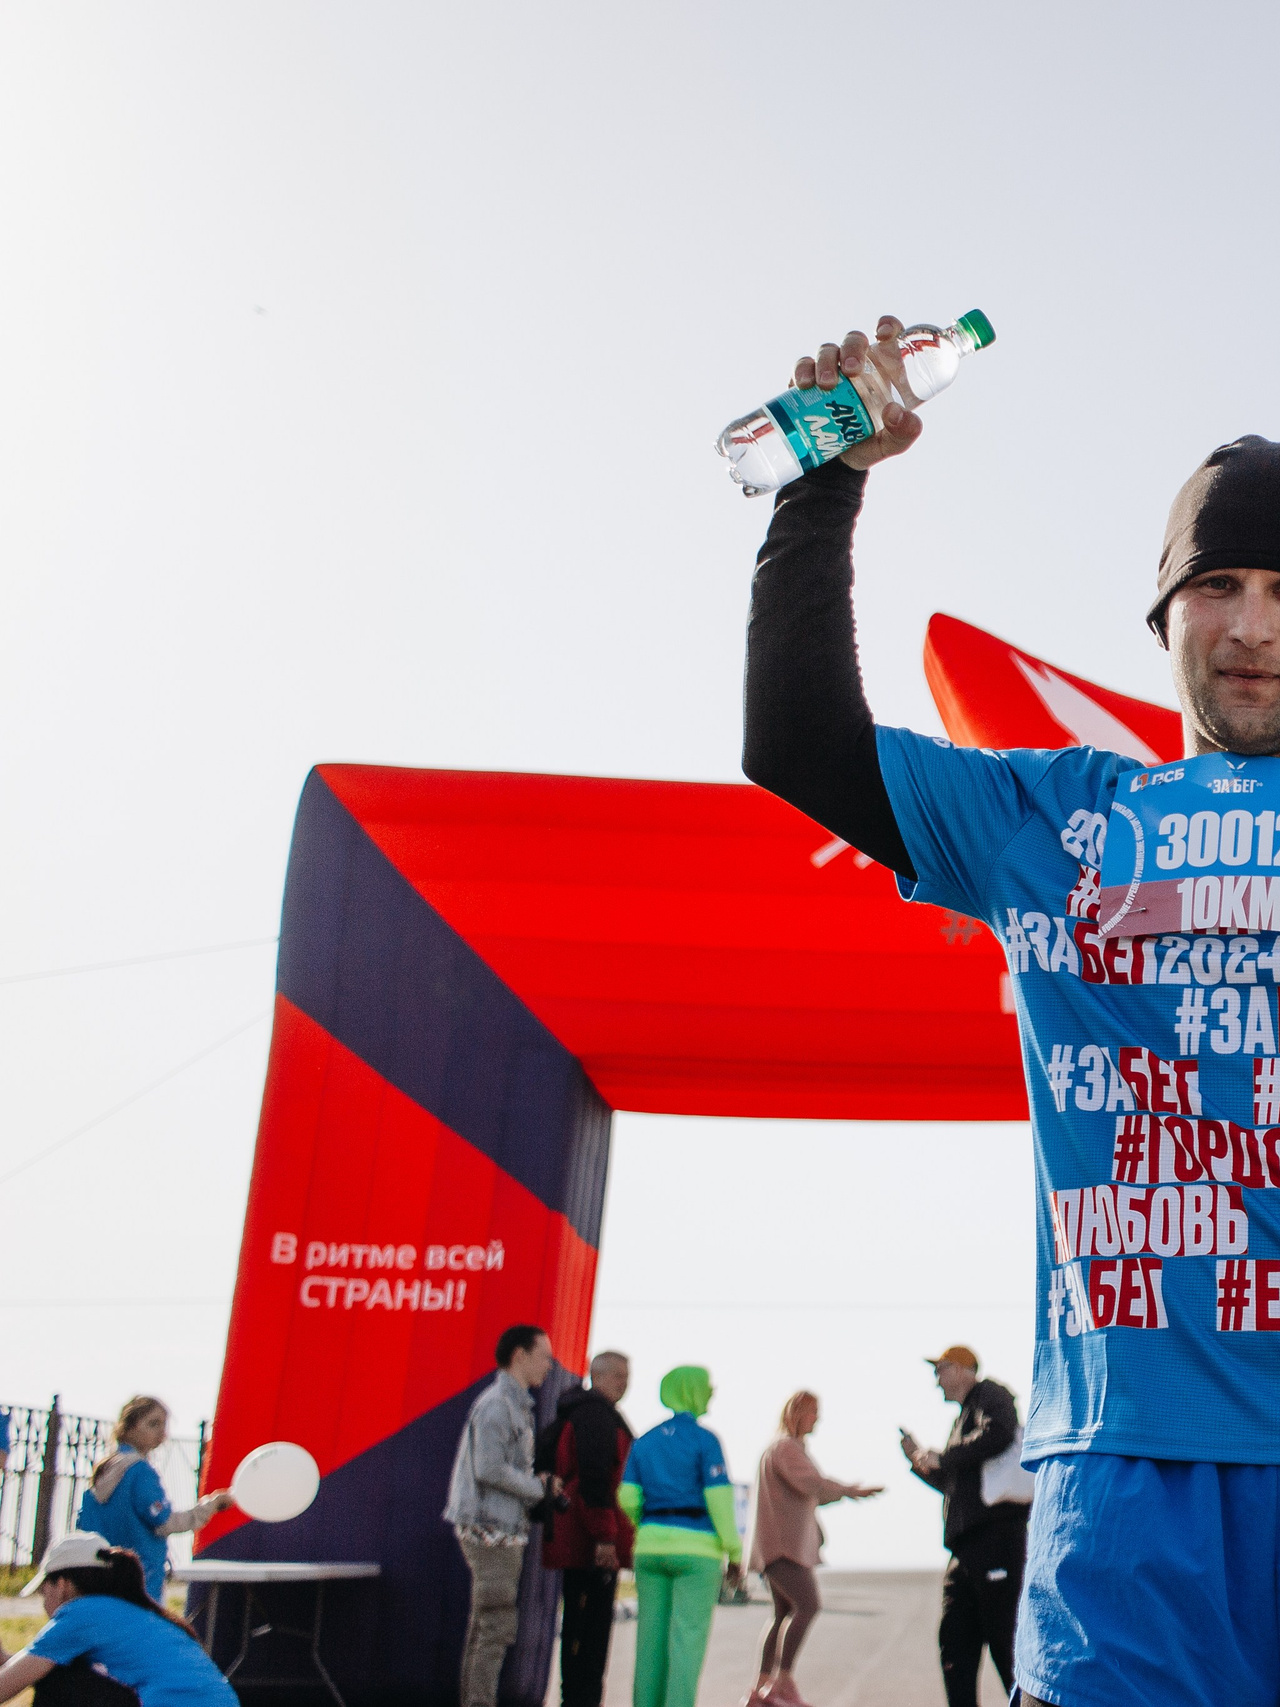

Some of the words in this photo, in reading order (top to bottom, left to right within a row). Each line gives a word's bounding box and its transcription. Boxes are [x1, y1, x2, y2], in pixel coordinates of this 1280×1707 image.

[803, 415, 846, 460] ЛАЙ
[825, 400, 866, 446] АКВ
[1151, 768, 1185, 785] ПСБ
[1061, 808, 1107, 870] 20
[1048, 1044, 1203, 1116] #ЗАБЕГ
[270, 1231, 298, 1265] В
[305, 1240, 418, 1271] ритме
[424, 1238, 506, 1272] всей
[300, 1274, 468, 1312] СТРАНЫ!
[1048, 1257, 1169, 1340] #ЗАБЕГ
